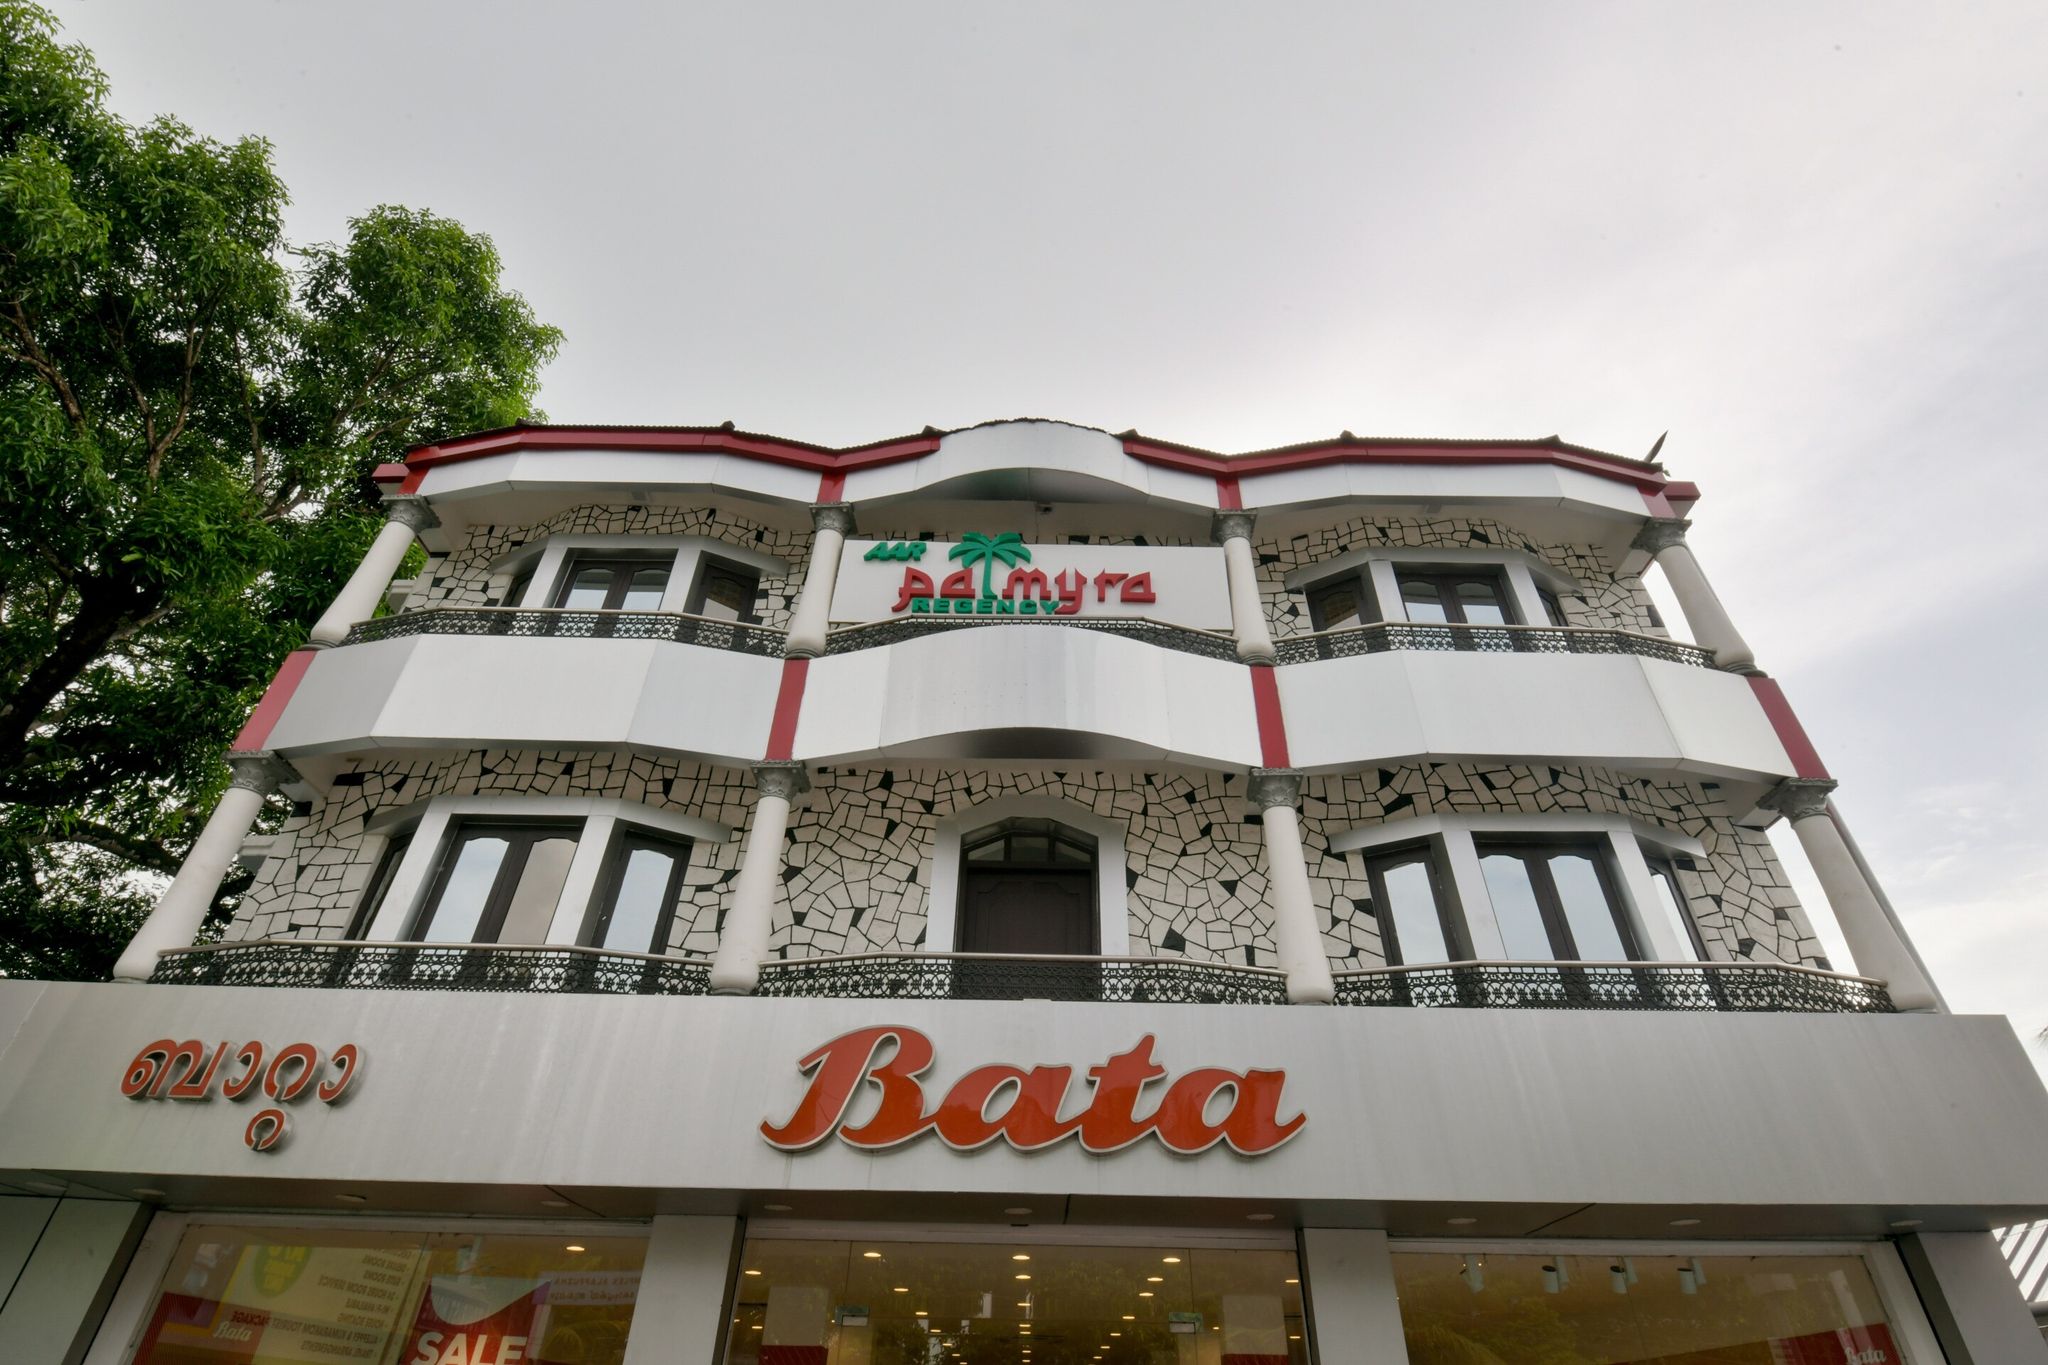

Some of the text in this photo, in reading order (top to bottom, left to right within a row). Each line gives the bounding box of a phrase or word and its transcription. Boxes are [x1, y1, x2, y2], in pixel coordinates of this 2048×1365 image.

[864, 541, 928, 562] AAR
[911, 598, 1059, 616] REGENCY
[757, 1023, 1308, 1157] Bata
[411, 1331, 528, 1365] SALE
